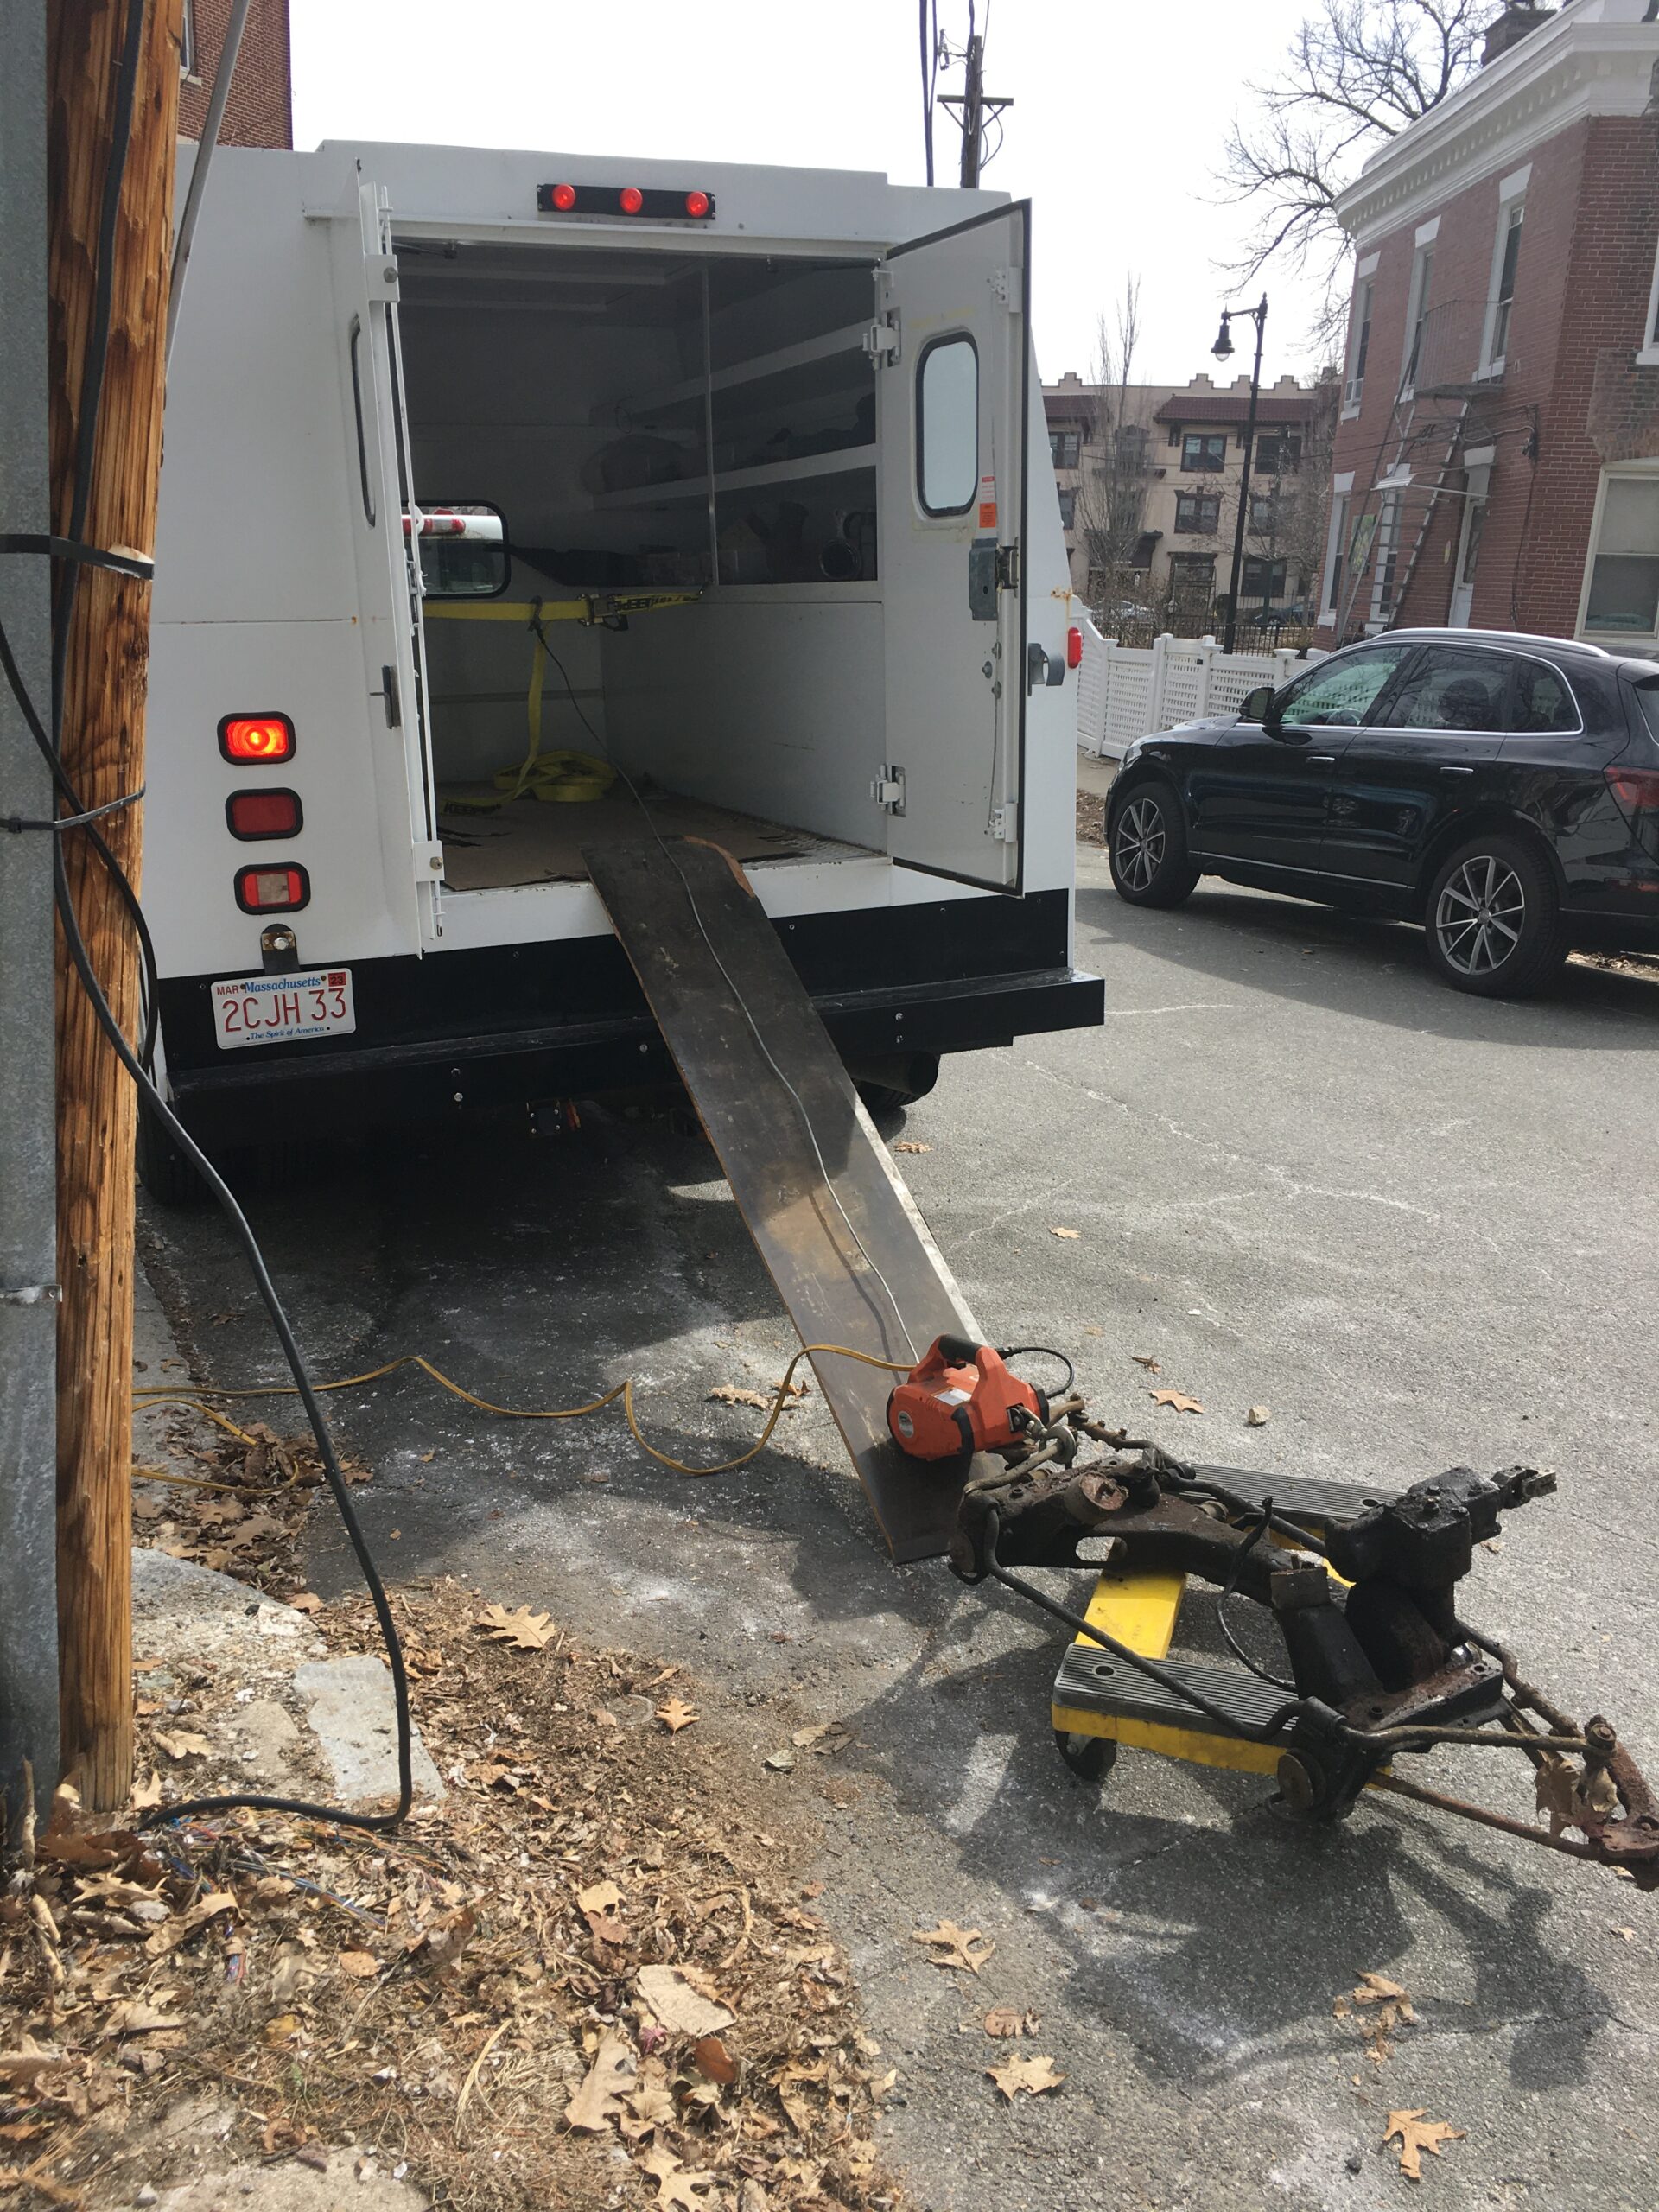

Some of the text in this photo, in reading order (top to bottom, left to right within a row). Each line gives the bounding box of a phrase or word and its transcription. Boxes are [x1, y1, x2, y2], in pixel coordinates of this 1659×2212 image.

[216, 976, 321, 995] MAR Massachusetts
[331, 975, 344, 985] 23
[222, 987, 346, 1033] 2CJH 33
[266, 1029, 285, 1039] Spirit
[296, 1026, 324, 1035] America
